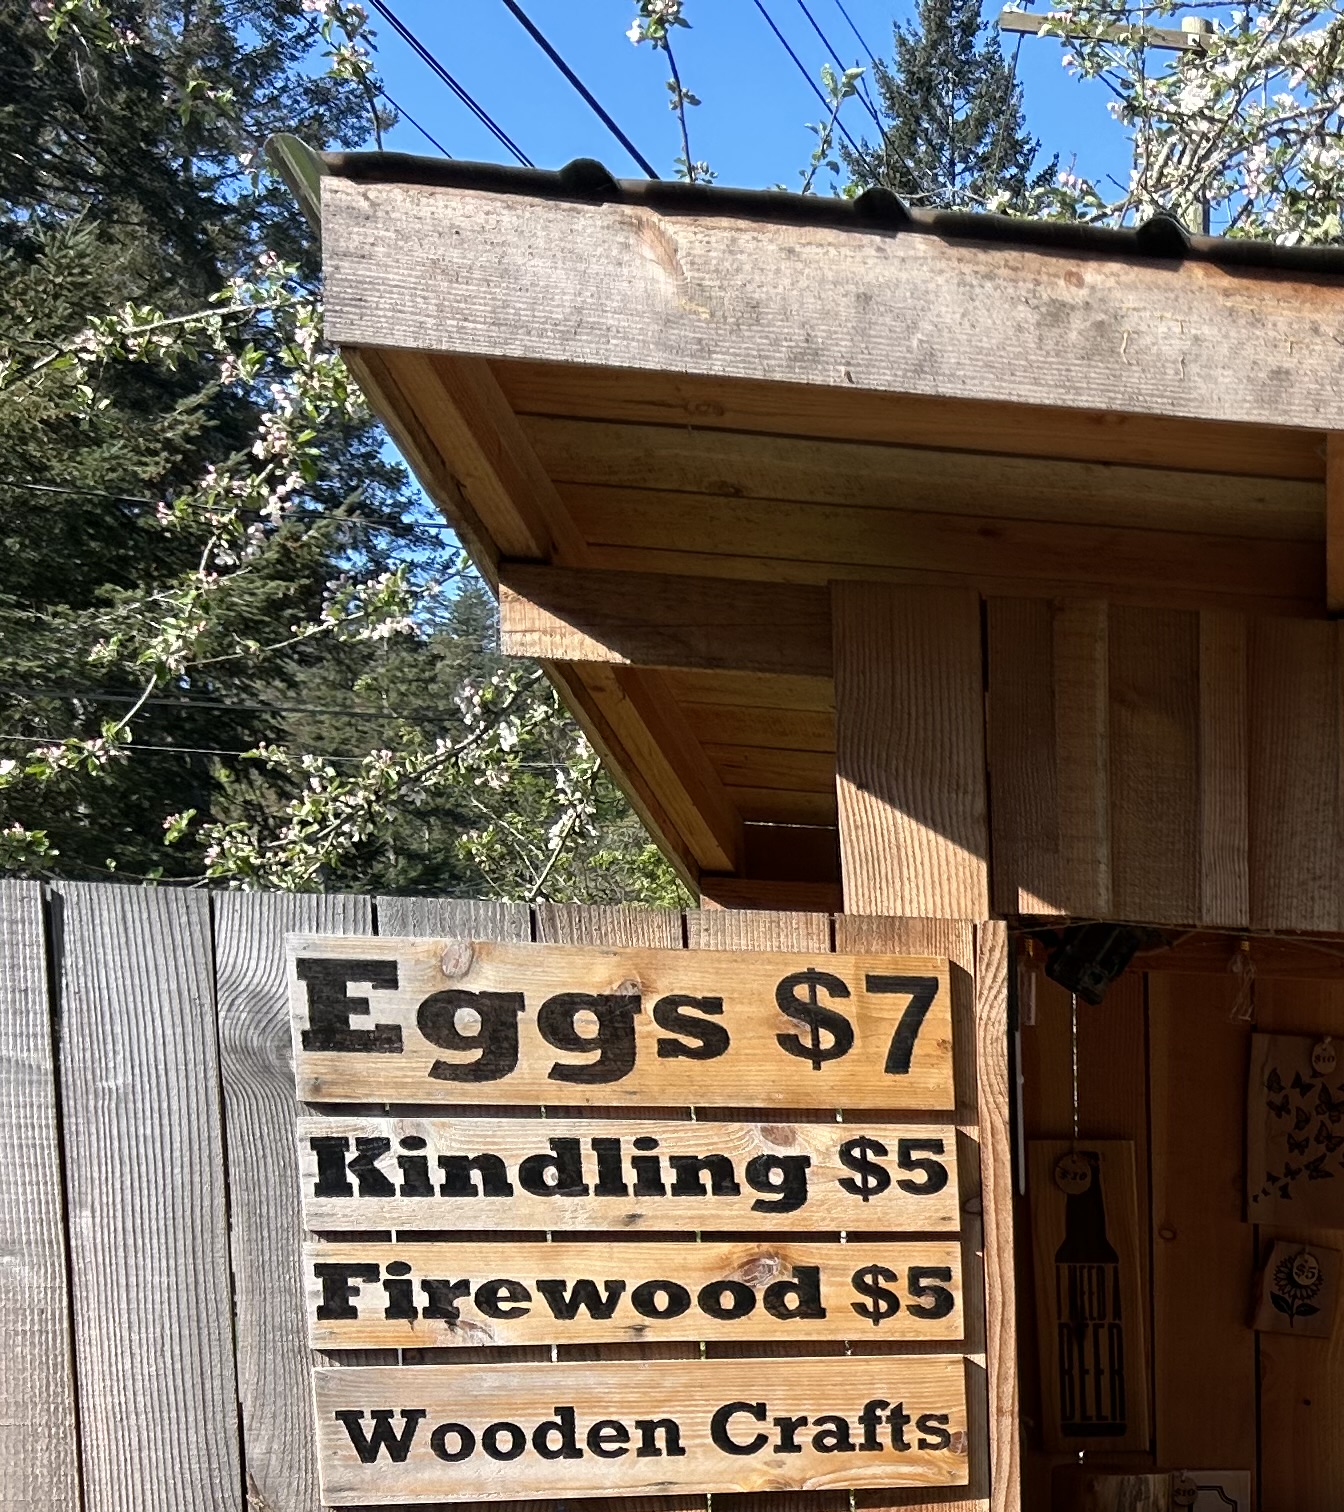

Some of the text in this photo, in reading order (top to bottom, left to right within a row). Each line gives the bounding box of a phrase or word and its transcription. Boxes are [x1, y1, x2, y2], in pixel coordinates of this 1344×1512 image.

[296, 957, 940, 1085] Eggs $7
[1314, 1054, 1335, 1065] $10
[308, 1135, 950, 1214] Kindling $5
[313, 1259, 956, 1327] Firewood $5
[1294, 1262, 1317, 1281] $5
[1058, 1321, 1127, 1422] BEER
[334, 1398, 953, 1464] Wooden Crafts
[1174, 1486, 1197, 1498] $10
